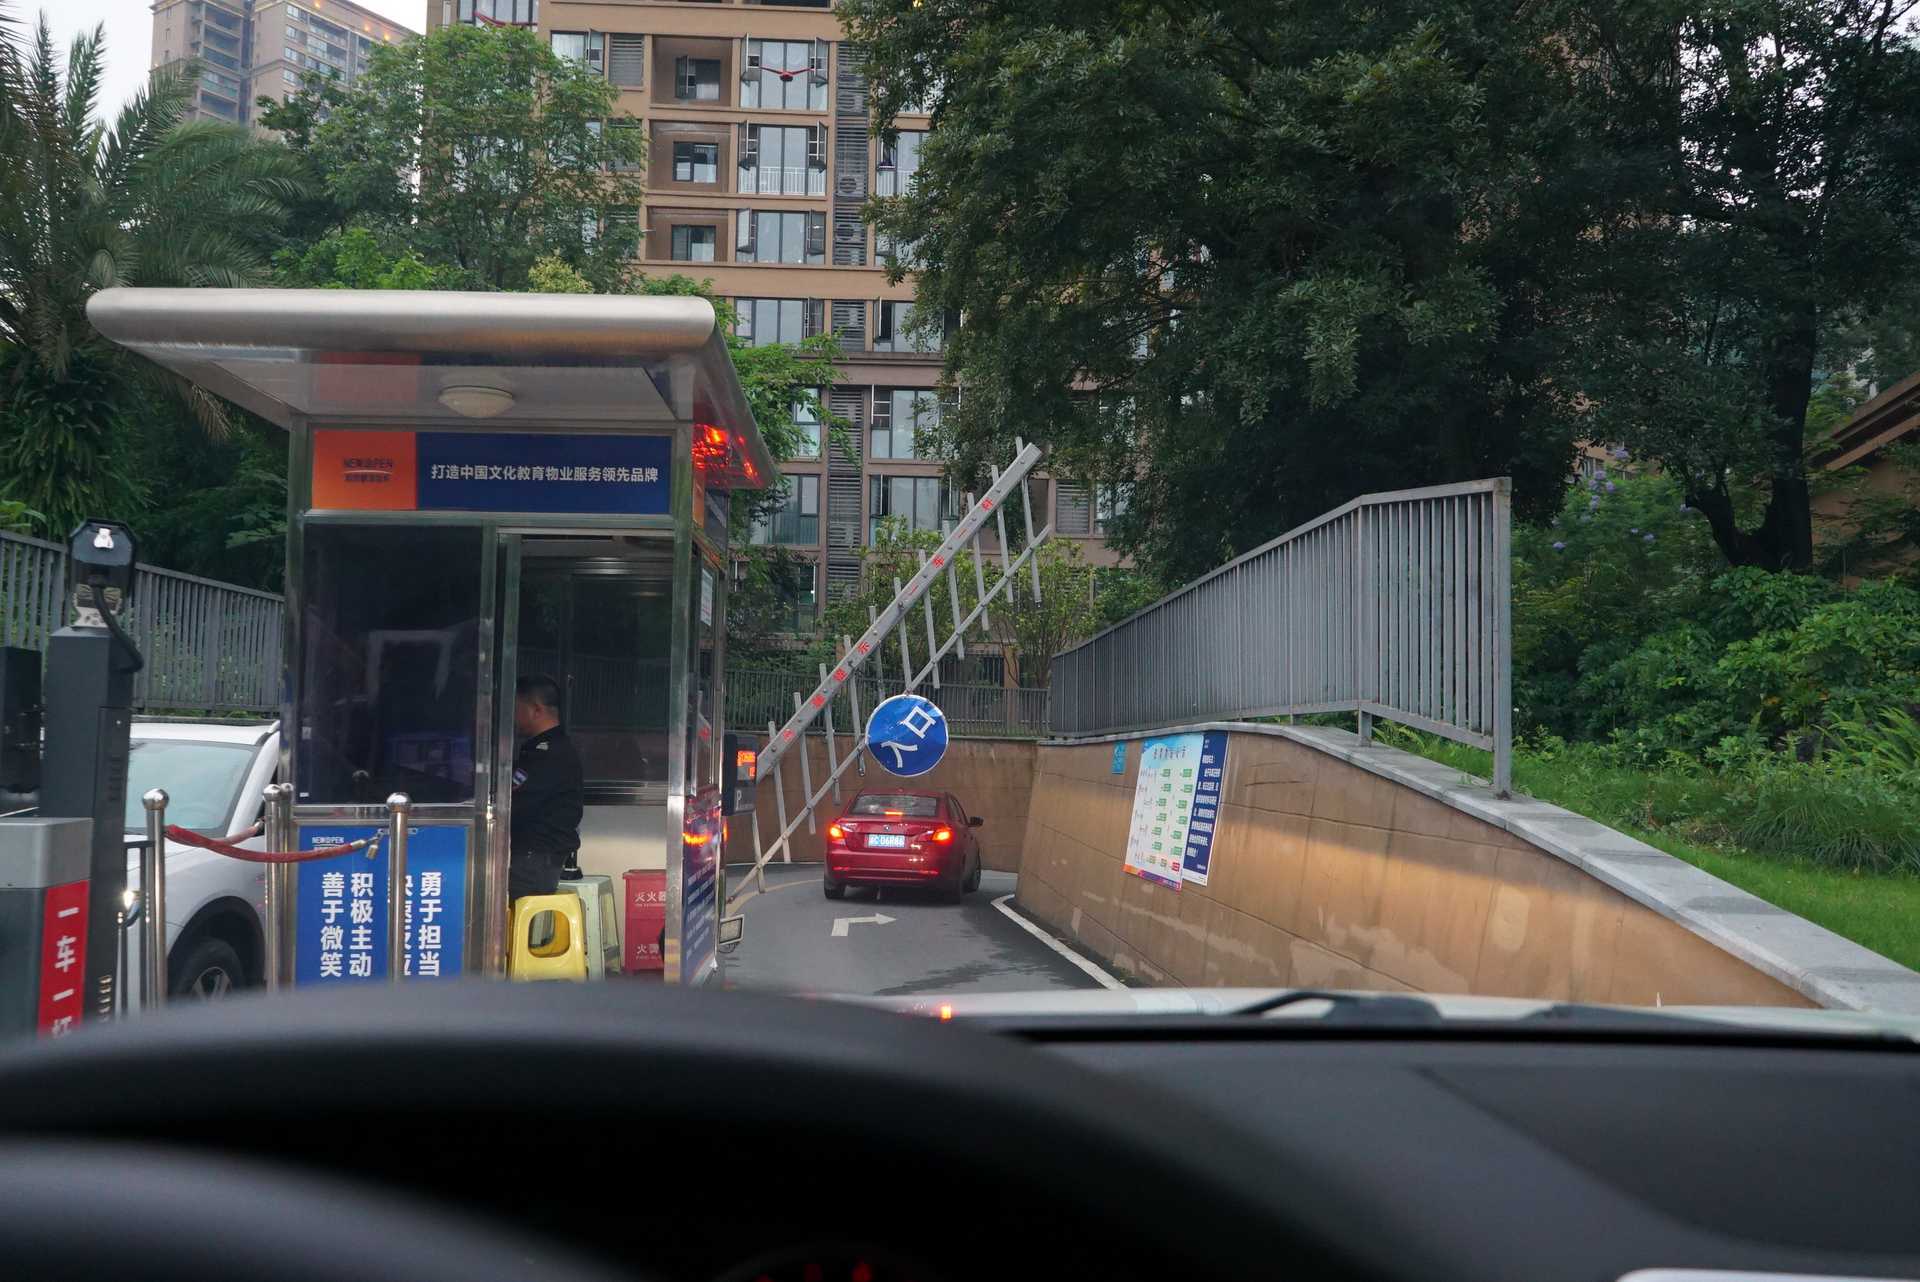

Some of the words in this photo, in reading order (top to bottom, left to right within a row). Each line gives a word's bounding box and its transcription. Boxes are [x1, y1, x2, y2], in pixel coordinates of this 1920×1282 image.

[431, 463, 659, 484] 打造中国文化教育物业服务领先品牌
[880, 705, 937, 769] 入口
[320, 872, 345, 977] 善于微笑
[349, 872, 374, 977] 积极主动
[418, 871, 443, 977] 勇于担当
